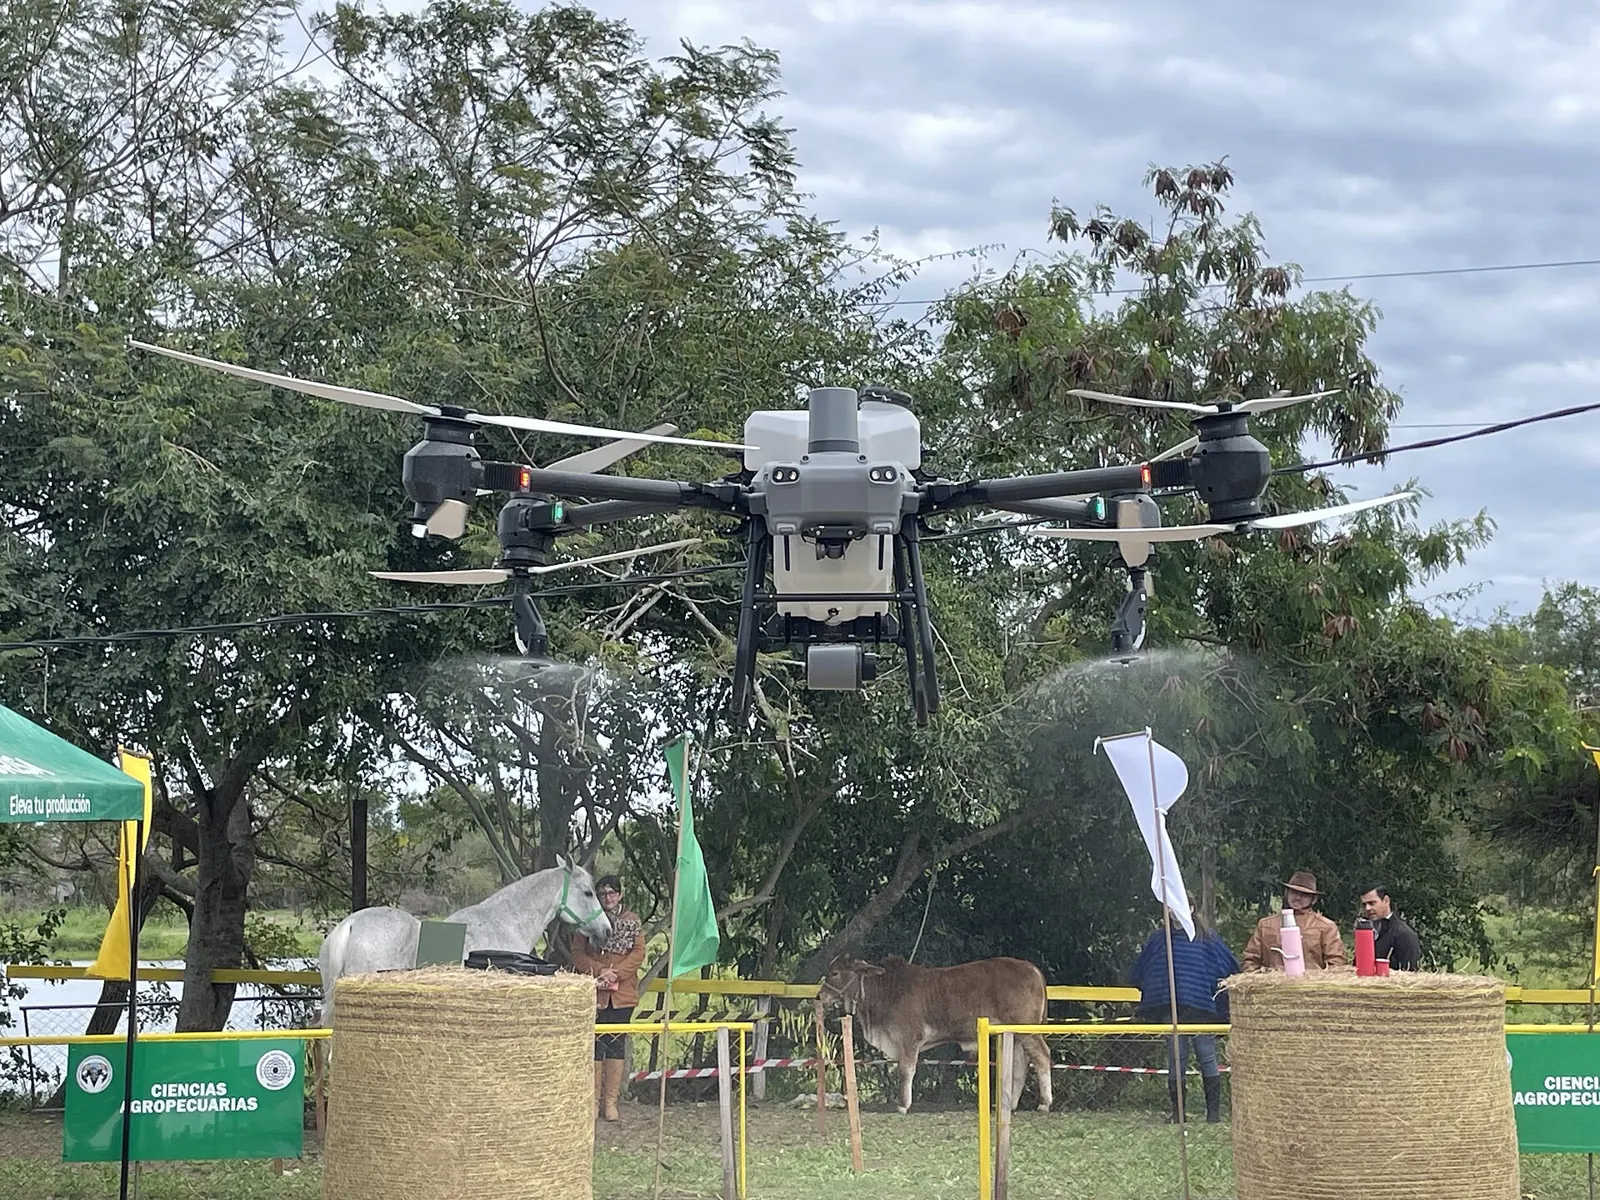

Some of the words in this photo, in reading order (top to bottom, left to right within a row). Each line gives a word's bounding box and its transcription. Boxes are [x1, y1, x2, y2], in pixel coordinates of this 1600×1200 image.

[9, 794, 33, 815] Eleva
[34, 796, 45, 814] tu
[46, 793, 91, 818] producción
[150, 1082, 228, 1098] CIENCIAS
[1544, 1076, 1600, 1091] CIENCI
